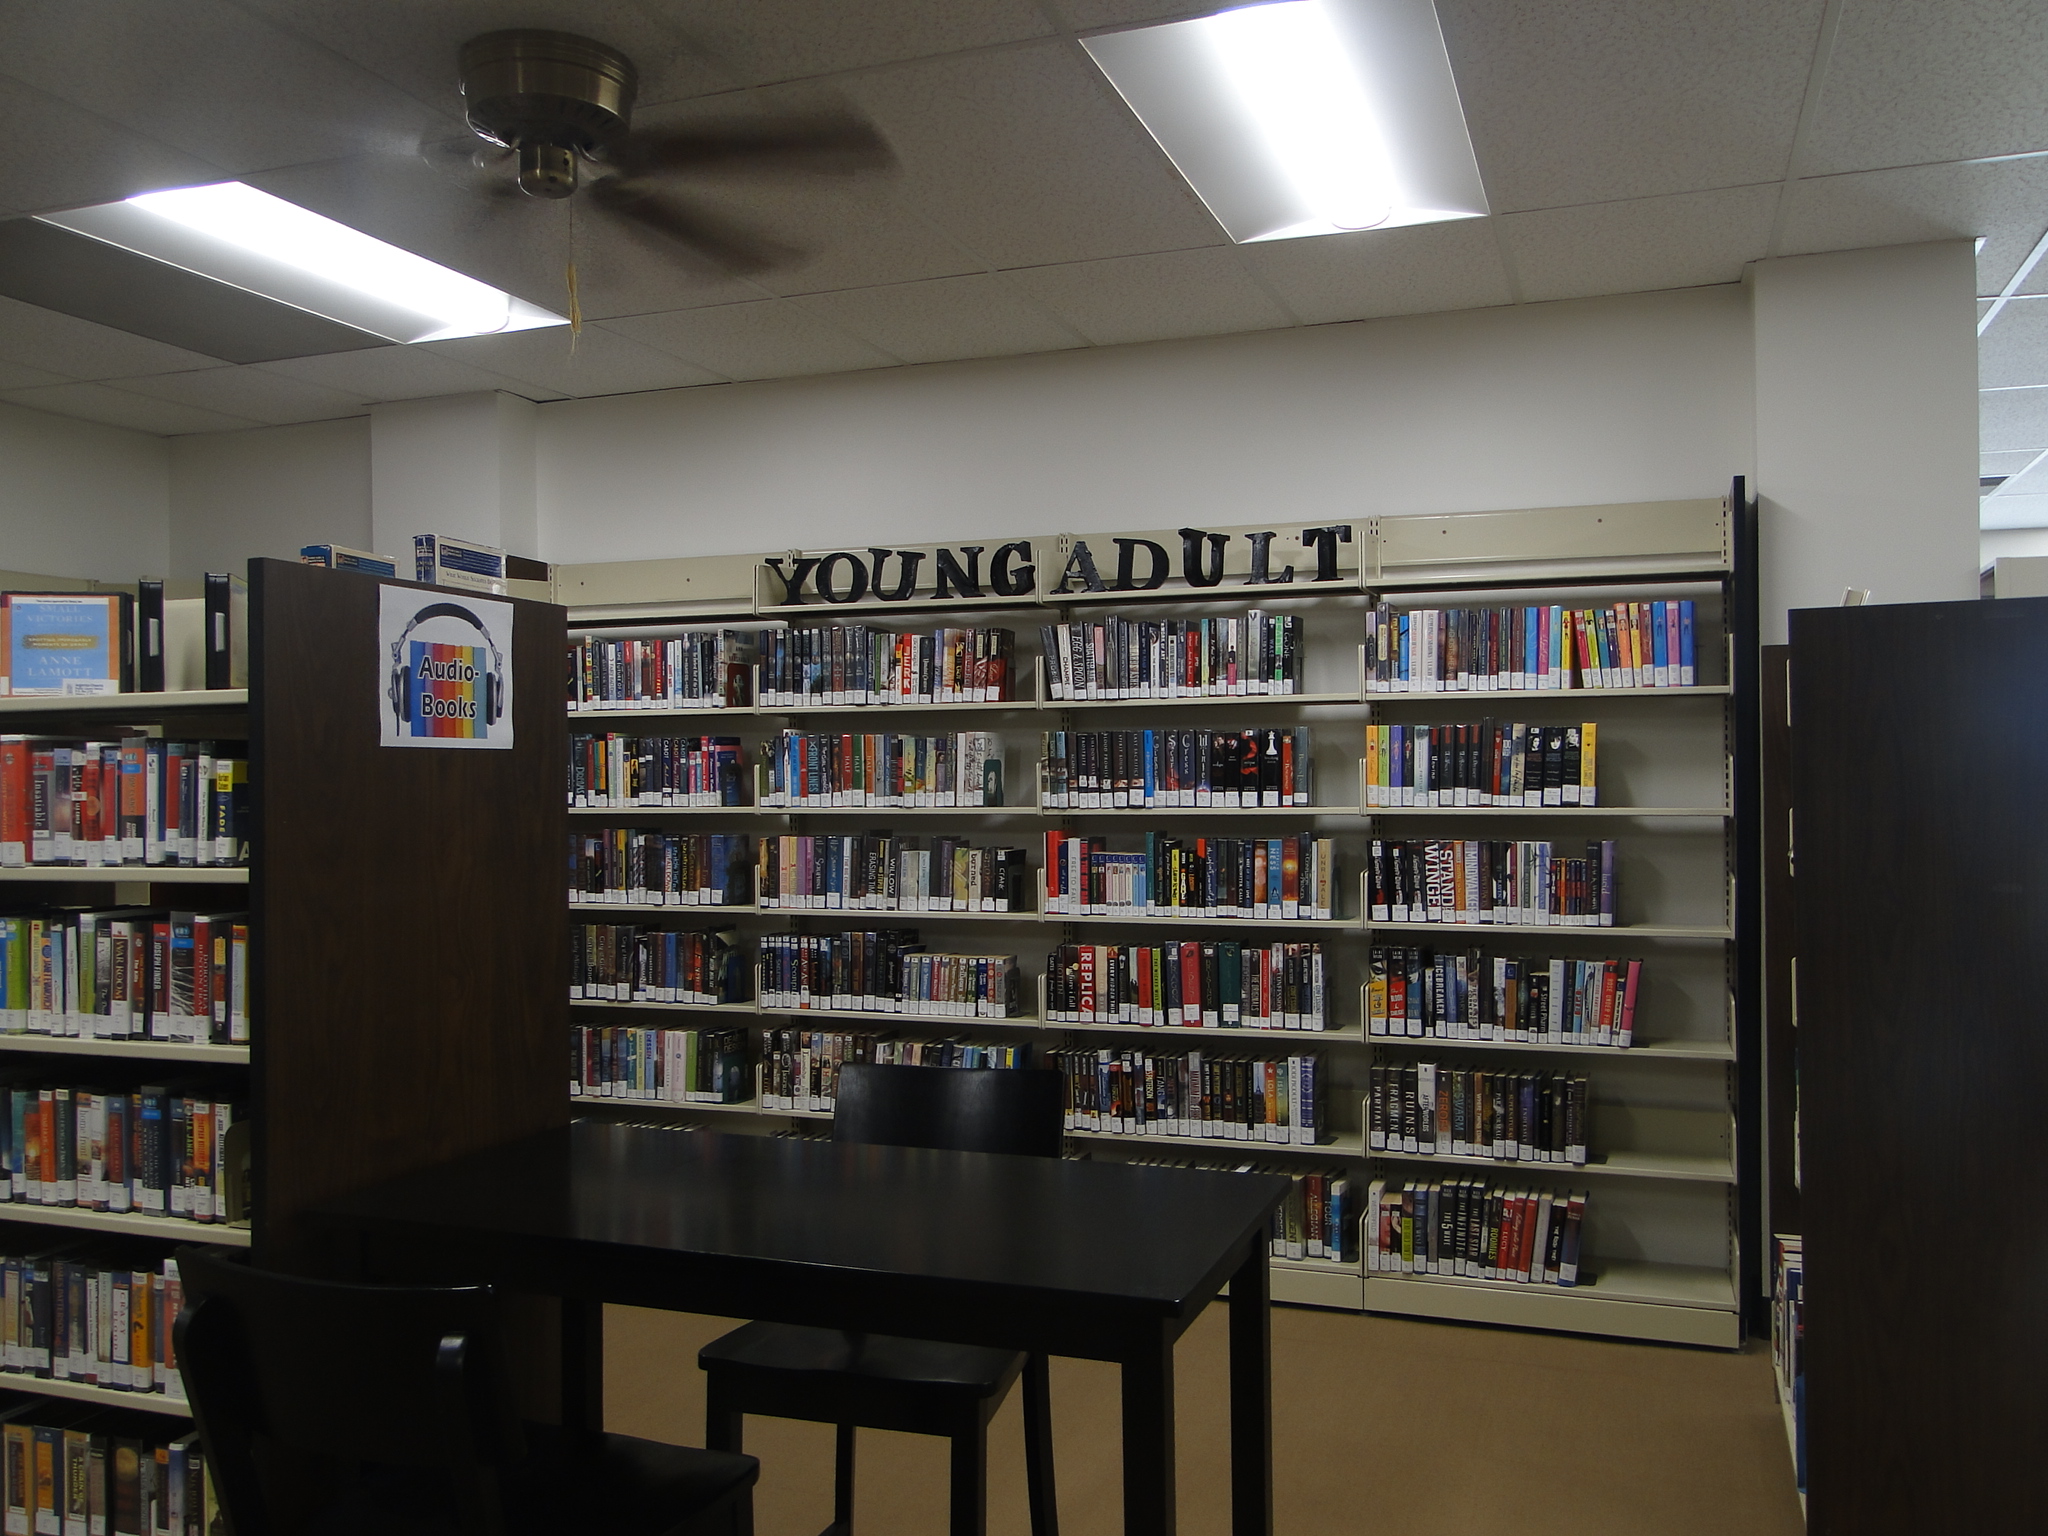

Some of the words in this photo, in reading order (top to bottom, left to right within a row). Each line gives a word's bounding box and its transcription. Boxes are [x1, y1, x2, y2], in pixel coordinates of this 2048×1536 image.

[766, 541, 1036, 606] YOUNG
[1050, 525, 1352, 594] ADULT
[1072, 636, 1082, 652] EGG
[1085, 643, 1094, 666] SHATTER
[28, 668, 92, 676] LAMOTT
[39, 656, 82, 665] ANNE
[418, 655, 480, 682] Audio-
[1073, 662, 1085, 688] SPOON
[421, 693, 477, 719] Books
[809, 747, 818, 769] FRONT
[1182, 734, 1191, 774] Cress
[809, 772, 818, 792] LINES
[34, 779, 46, 827] Insatiable
[1424, 843, 1440, 906] WINGE
[1439, 850, 1454, 906] STAND
[1466, 852, 1477, 911] MINDWALKER
[1601, 873, 1612, 894] lucid
[115, 940, 124, 963] WAR
[154, 941, 162, 965] JOSEPH
[115, 965, 125, 999] ROOM
[153, 966, 162, 990] FINDER
[1081, 953, 1093, 1014] REPLICA
[1436, 966, 1445, 1014] ICEBREAKER
[1068, 996, 1076, 1007] fall
[1157, 1076, 1165, 1095] FANG
[1373, 1086, 1381, 1131] PARTIALS
[1405, 1091, 1414, 1134] RUINS
[1422, 1094, 1430, 1132] AFTERWORLDS
[1455, 1093, 1464, 1130] SWARM
[78, 1110, 88, 1133] home
[79, 1135, 88, 1156] front
[186, 1134, 194, 1157] JANCE
[1324, 1201, 1332, 1226] FOUR
[1443, 1230, 1451, 1246] WAVE
[1456, 1211, 1466, 1251] INFINITE
[1470, 1218, 1479, 1237] LAST
[1469, 1239, 1479, 1256] STAR
[1489, 1227, 1499, 1260] ROOMIES
[56, 1263, 64, 1288] JAMES
[56, 1289, 64, 1335] PATTERSON
